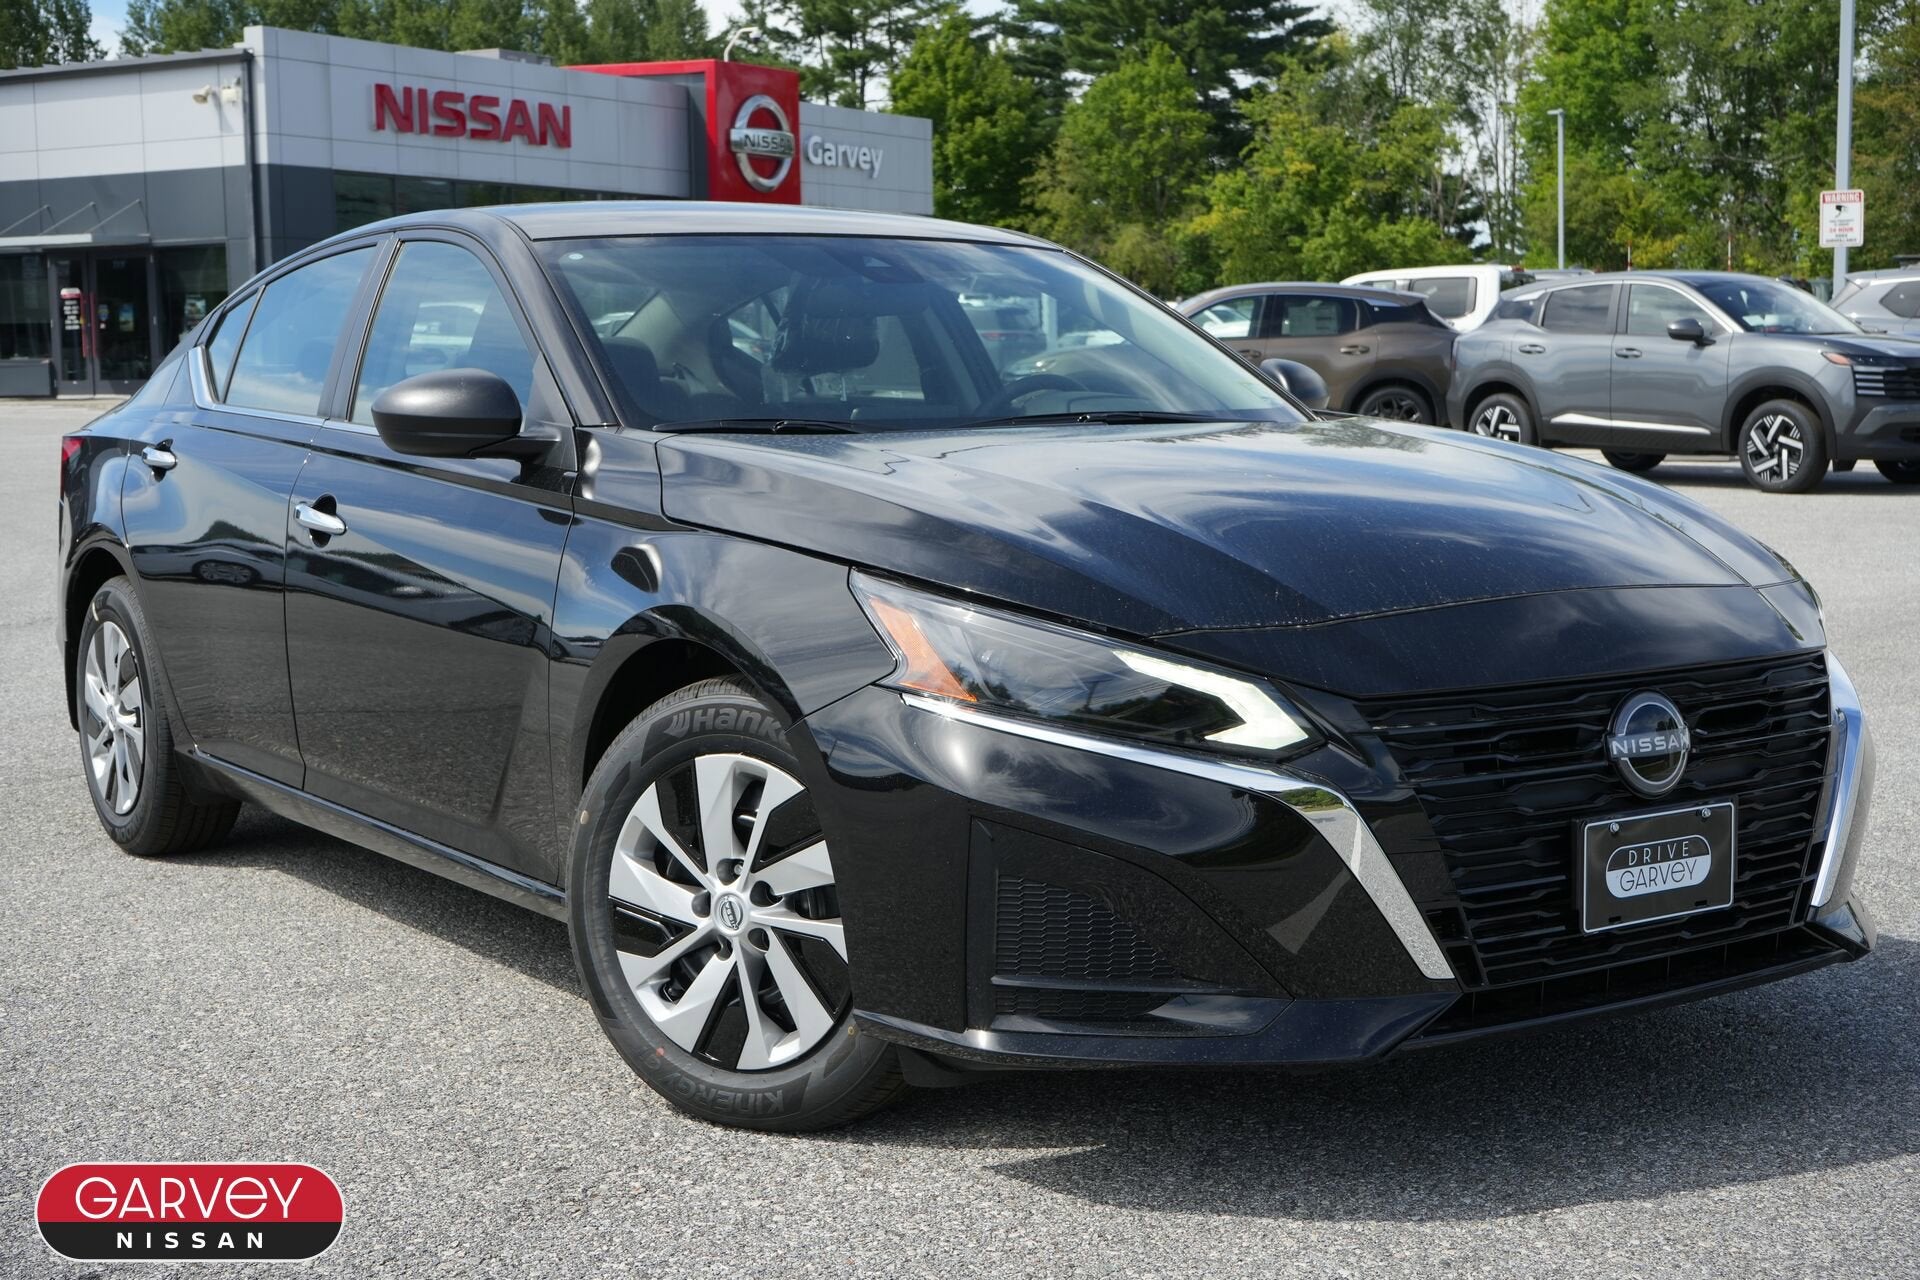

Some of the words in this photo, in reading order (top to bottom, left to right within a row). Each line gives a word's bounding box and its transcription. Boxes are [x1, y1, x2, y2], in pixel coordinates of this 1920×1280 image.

[374, 83, 571, 148] NISSAN
[808, 135, 883, 179] Garvey
[1824, 192, 1860, 203] WARNING
[1612, 731, 1690, 756] NISSAN
[1628, 841, 1689, 866] DRIVE
